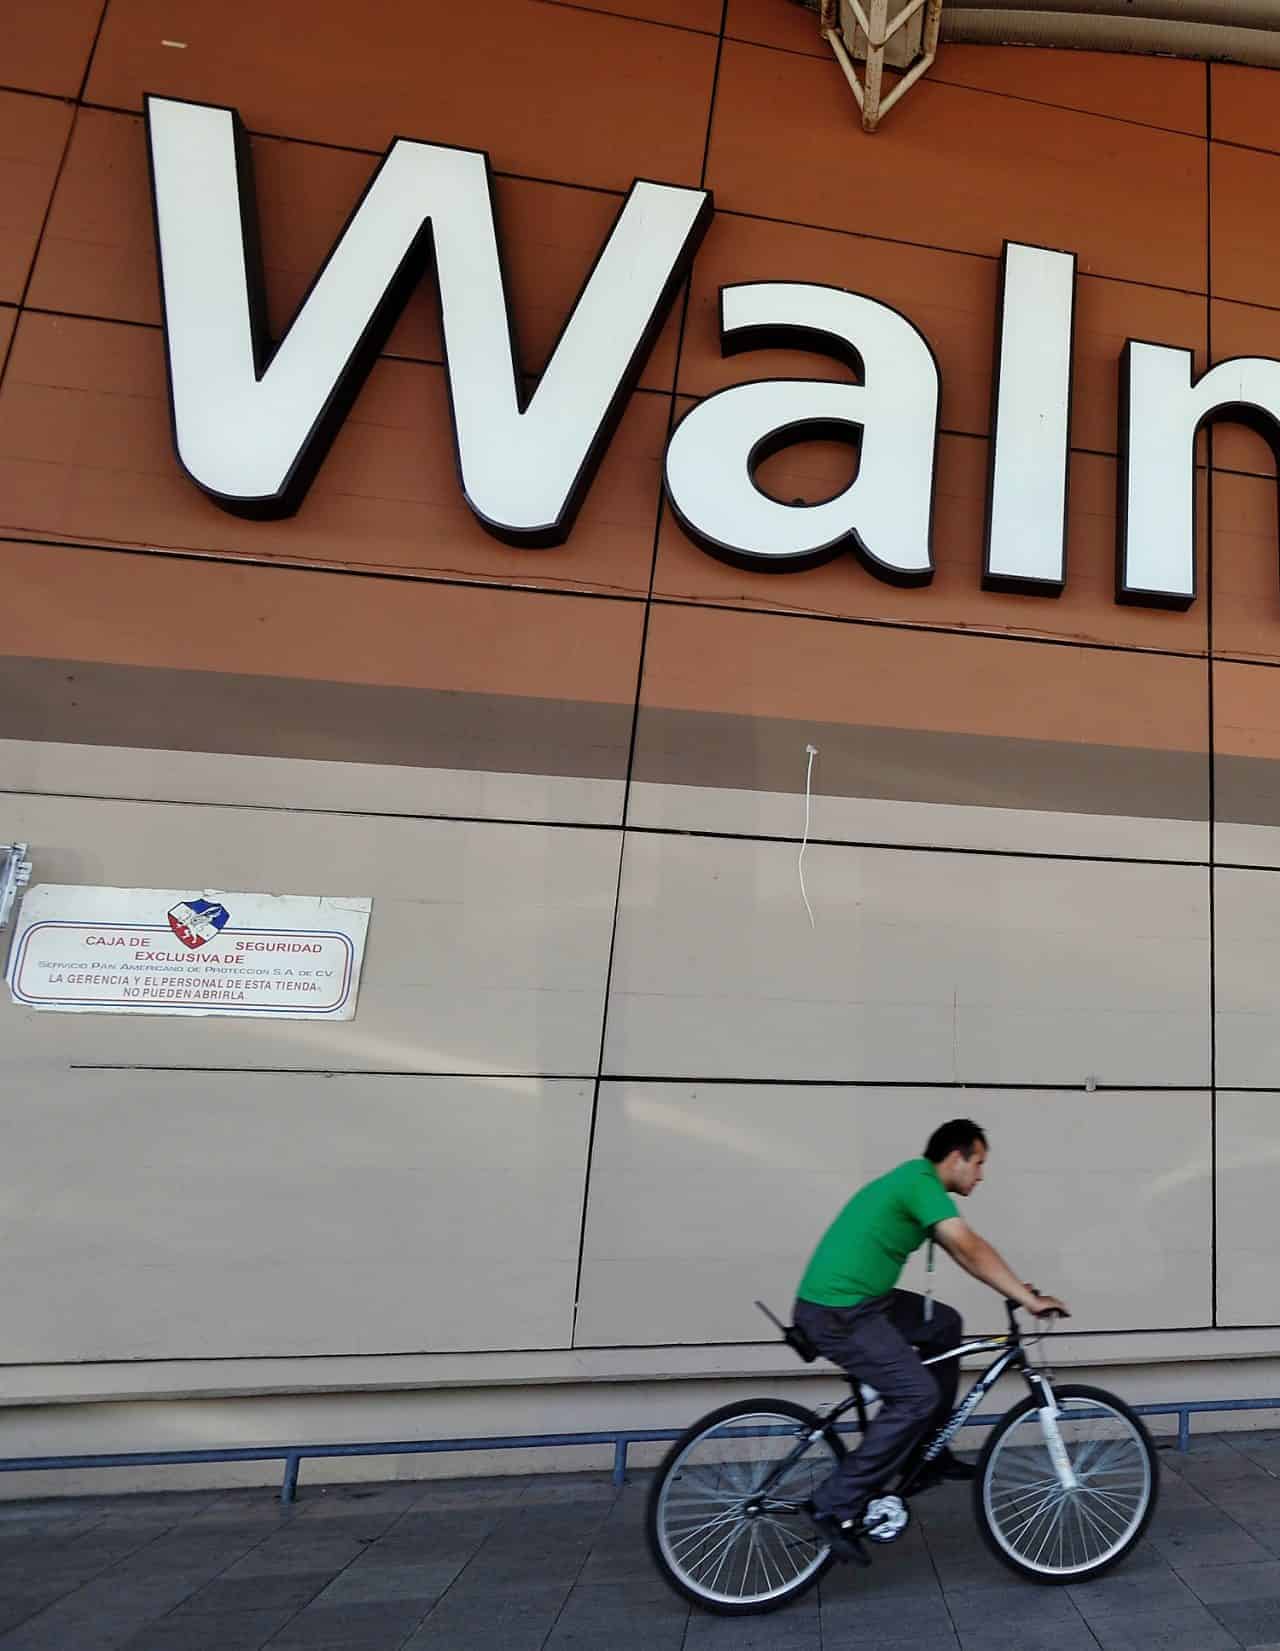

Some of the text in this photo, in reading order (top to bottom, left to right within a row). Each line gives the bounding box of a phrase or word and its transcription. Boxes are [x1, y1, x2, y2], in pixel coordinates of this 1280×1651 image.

[86, 936, 322, 953] CAJA DE SEGURIDAD
[135, 951, 245, 964] EXCLUSIVA DE
[92, 962, 117, 970] PAN
[48, 973, 63, 983] LA
[67, 974, 129, 985] GERENCIA
[134, 976, 141, 985] Y
[144, 977, 157, 986] EL
[161, 977, 223, 989] PERSONAL
[226, 979, 245, 989] DE
[244, 980, 272, 990] ESTA
[123, 988, 245, 1000] NO PUEDEN ABRIRLA
